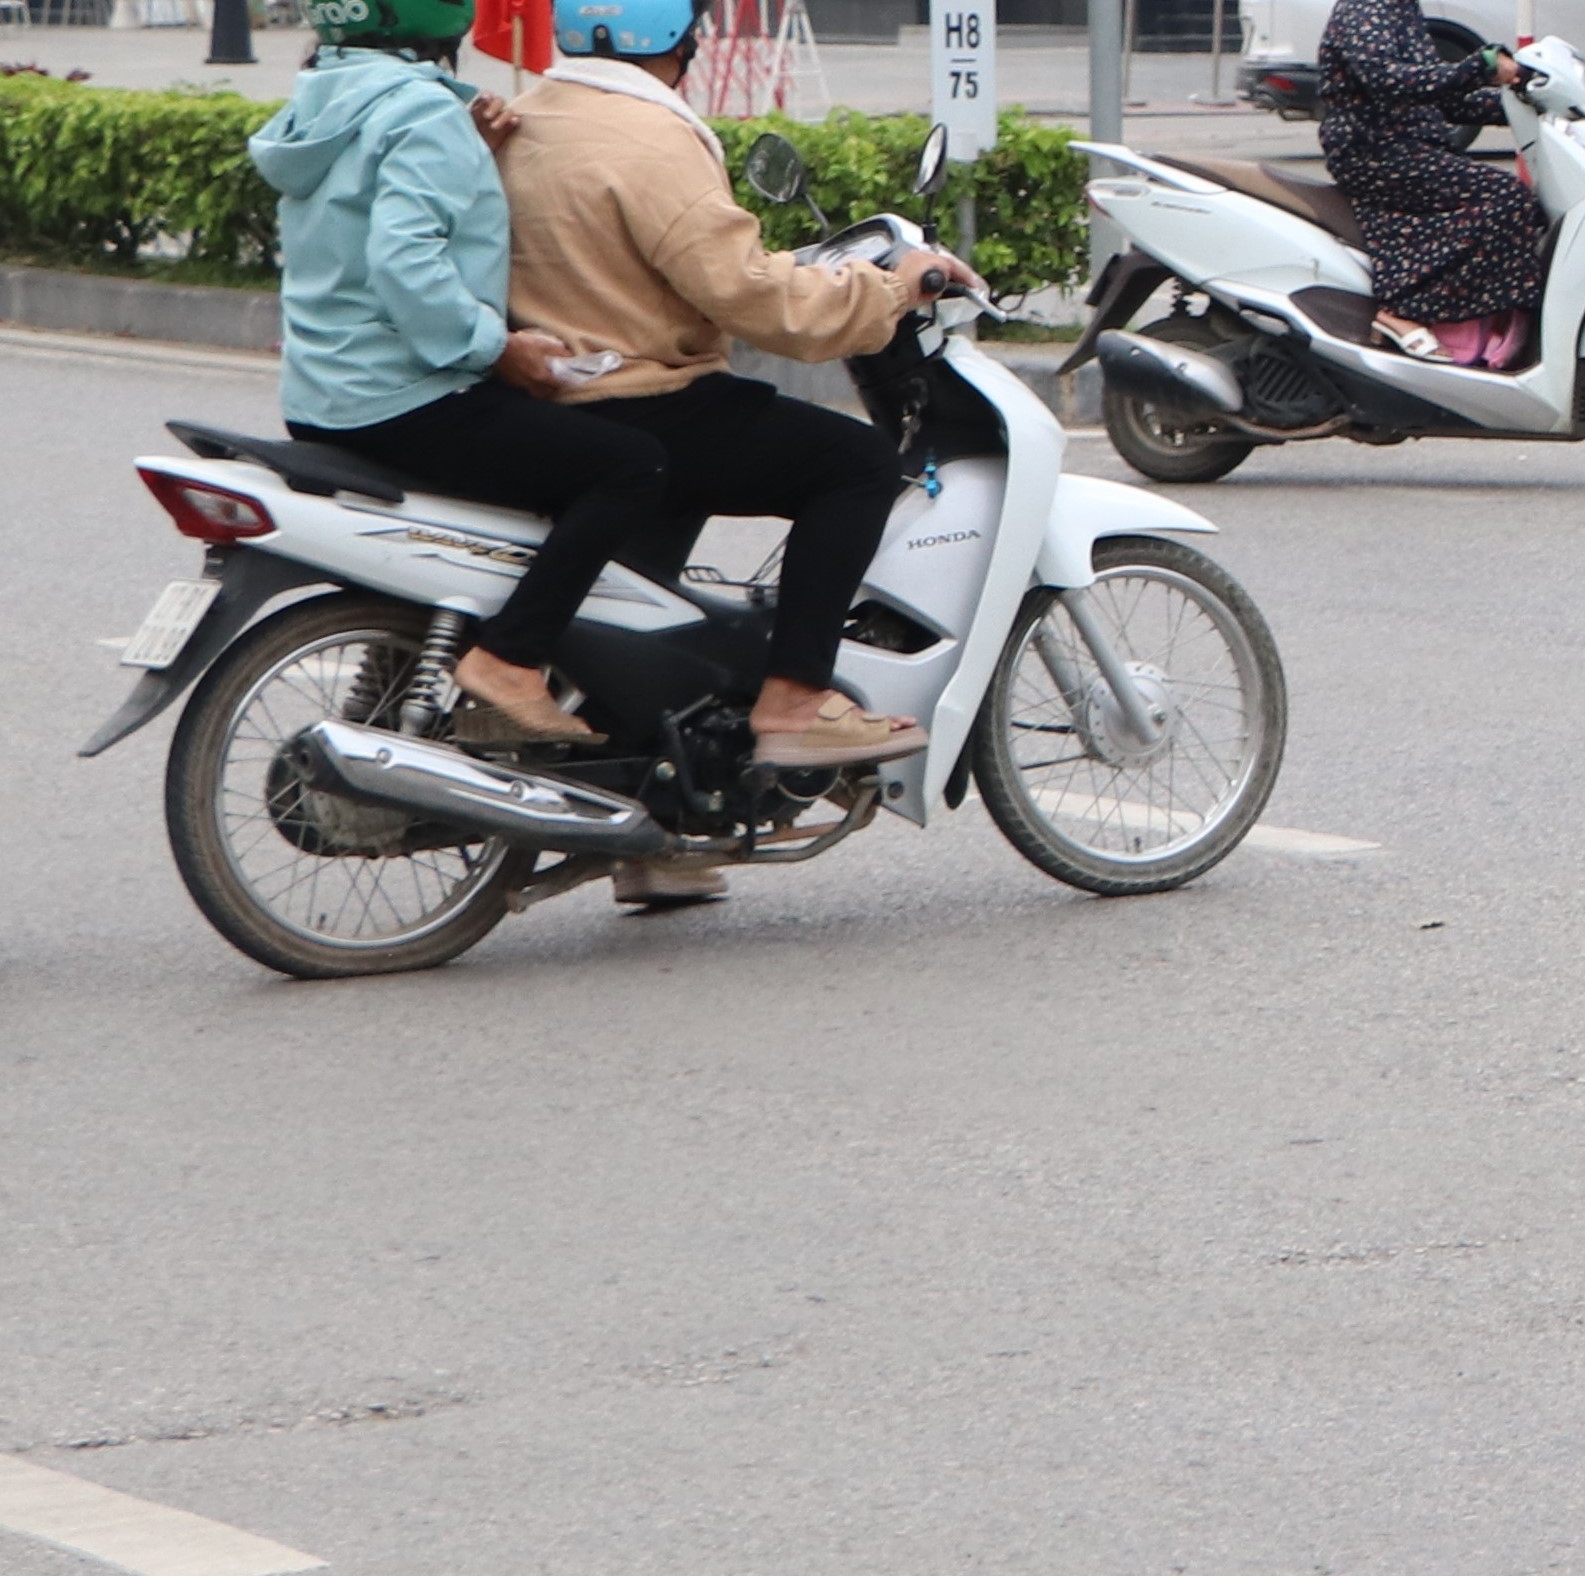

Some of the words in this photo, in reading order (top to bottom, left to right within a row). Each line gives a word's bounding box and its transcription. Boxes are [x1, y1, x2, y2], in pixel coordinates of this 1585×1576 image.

[945, 12, 980, 49] H8
[950, 71, 979, 100] 75
[907, 529, 981, 551] HONDA
